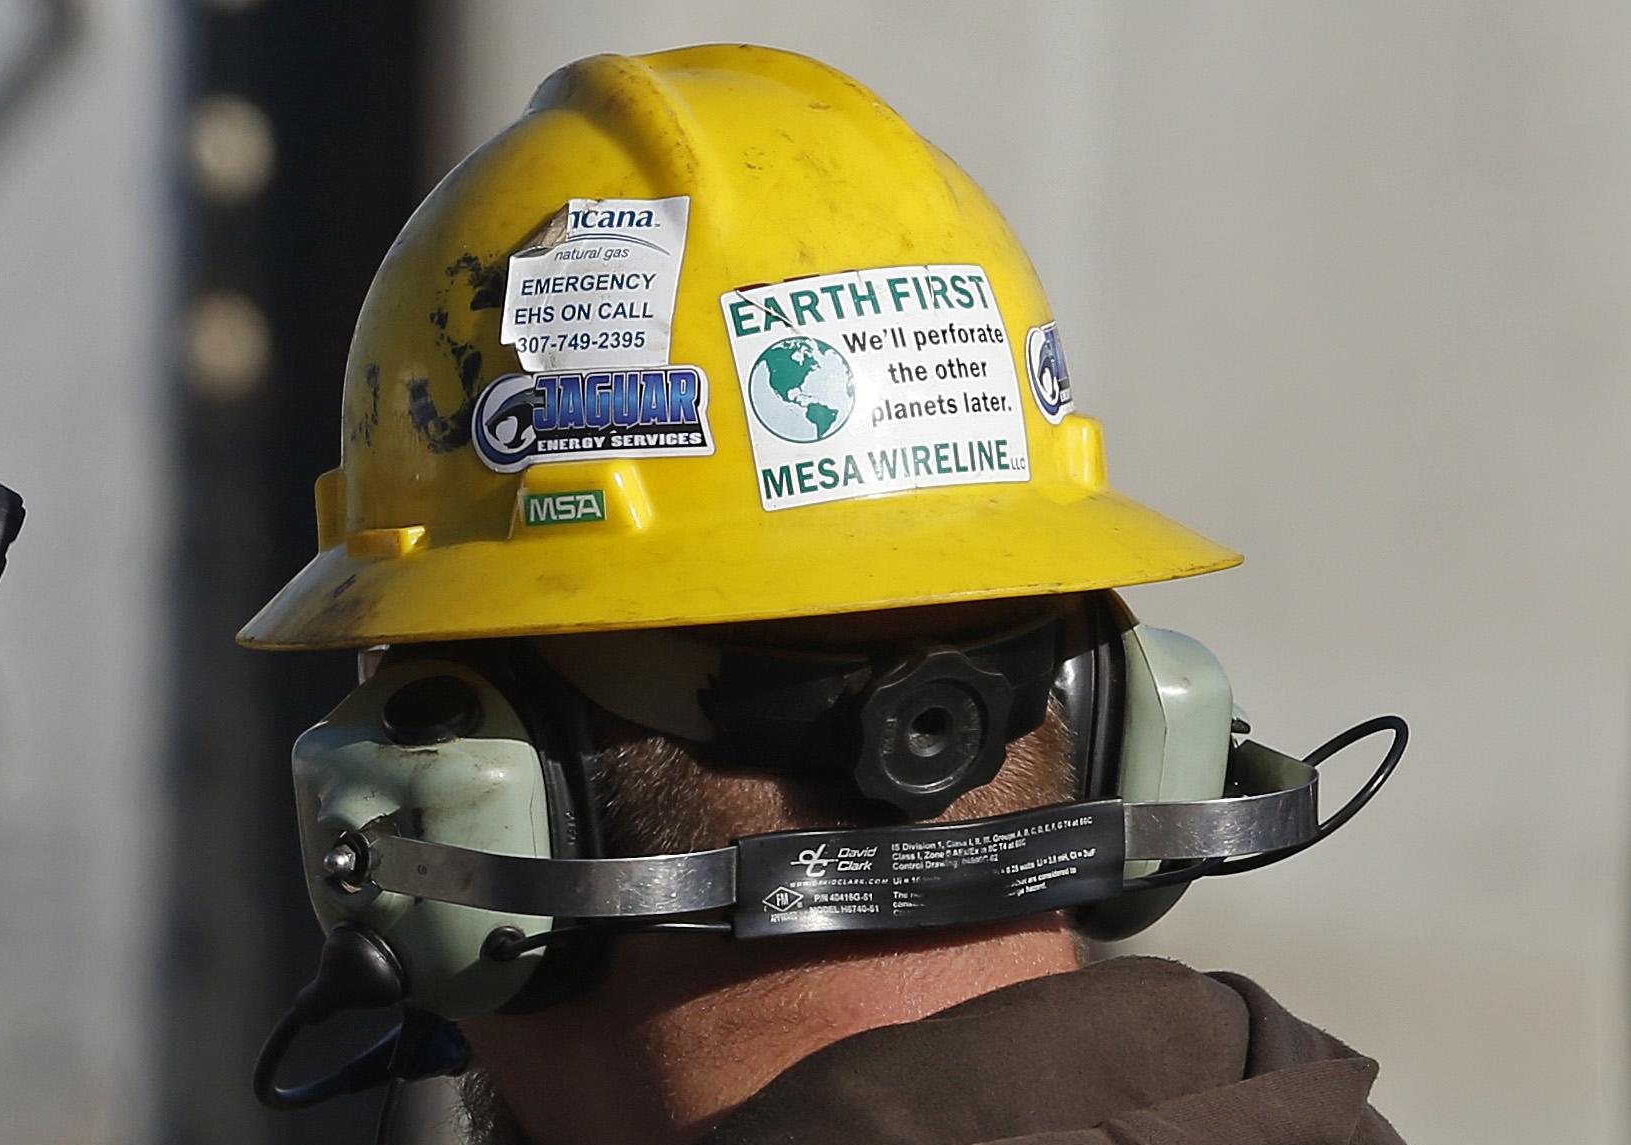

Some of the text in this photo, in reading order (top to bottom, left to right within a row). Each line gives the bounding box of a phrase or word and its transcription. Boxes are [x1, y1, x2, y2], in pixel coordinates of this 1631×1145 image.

[554, 247, 630, 262] natural gas
[521, 273, 657, 296] EMERGENCY
[514, 302, 654, 325] EHS ON CALL
[728, 274, 990, 338] EARTH FIRST
[518, 331, 646, 354] 307-749-2395
[842, 322, 1005, 355] We'll perforate
[887, 356, 988, 385] the other
[533, 371, 698, 431] JAGUAR
[871, 393, 1013, 427] planets later.
[537, 431, 703, 452] ENERGY SERVICES
[761, 454, 865, 501] MESA
[867, 439, 1010, 482] WIRELINE
[529, 494, 603, 523] MSA
[837, 846, 878, 859] David
[892, 852, 915, 861] Class
[924, 850, 945, 860] Zone
[902, 841, 936, 852] Division
[837, 860, 873, 872] Clark
[892, 861, 923, 871] Control
